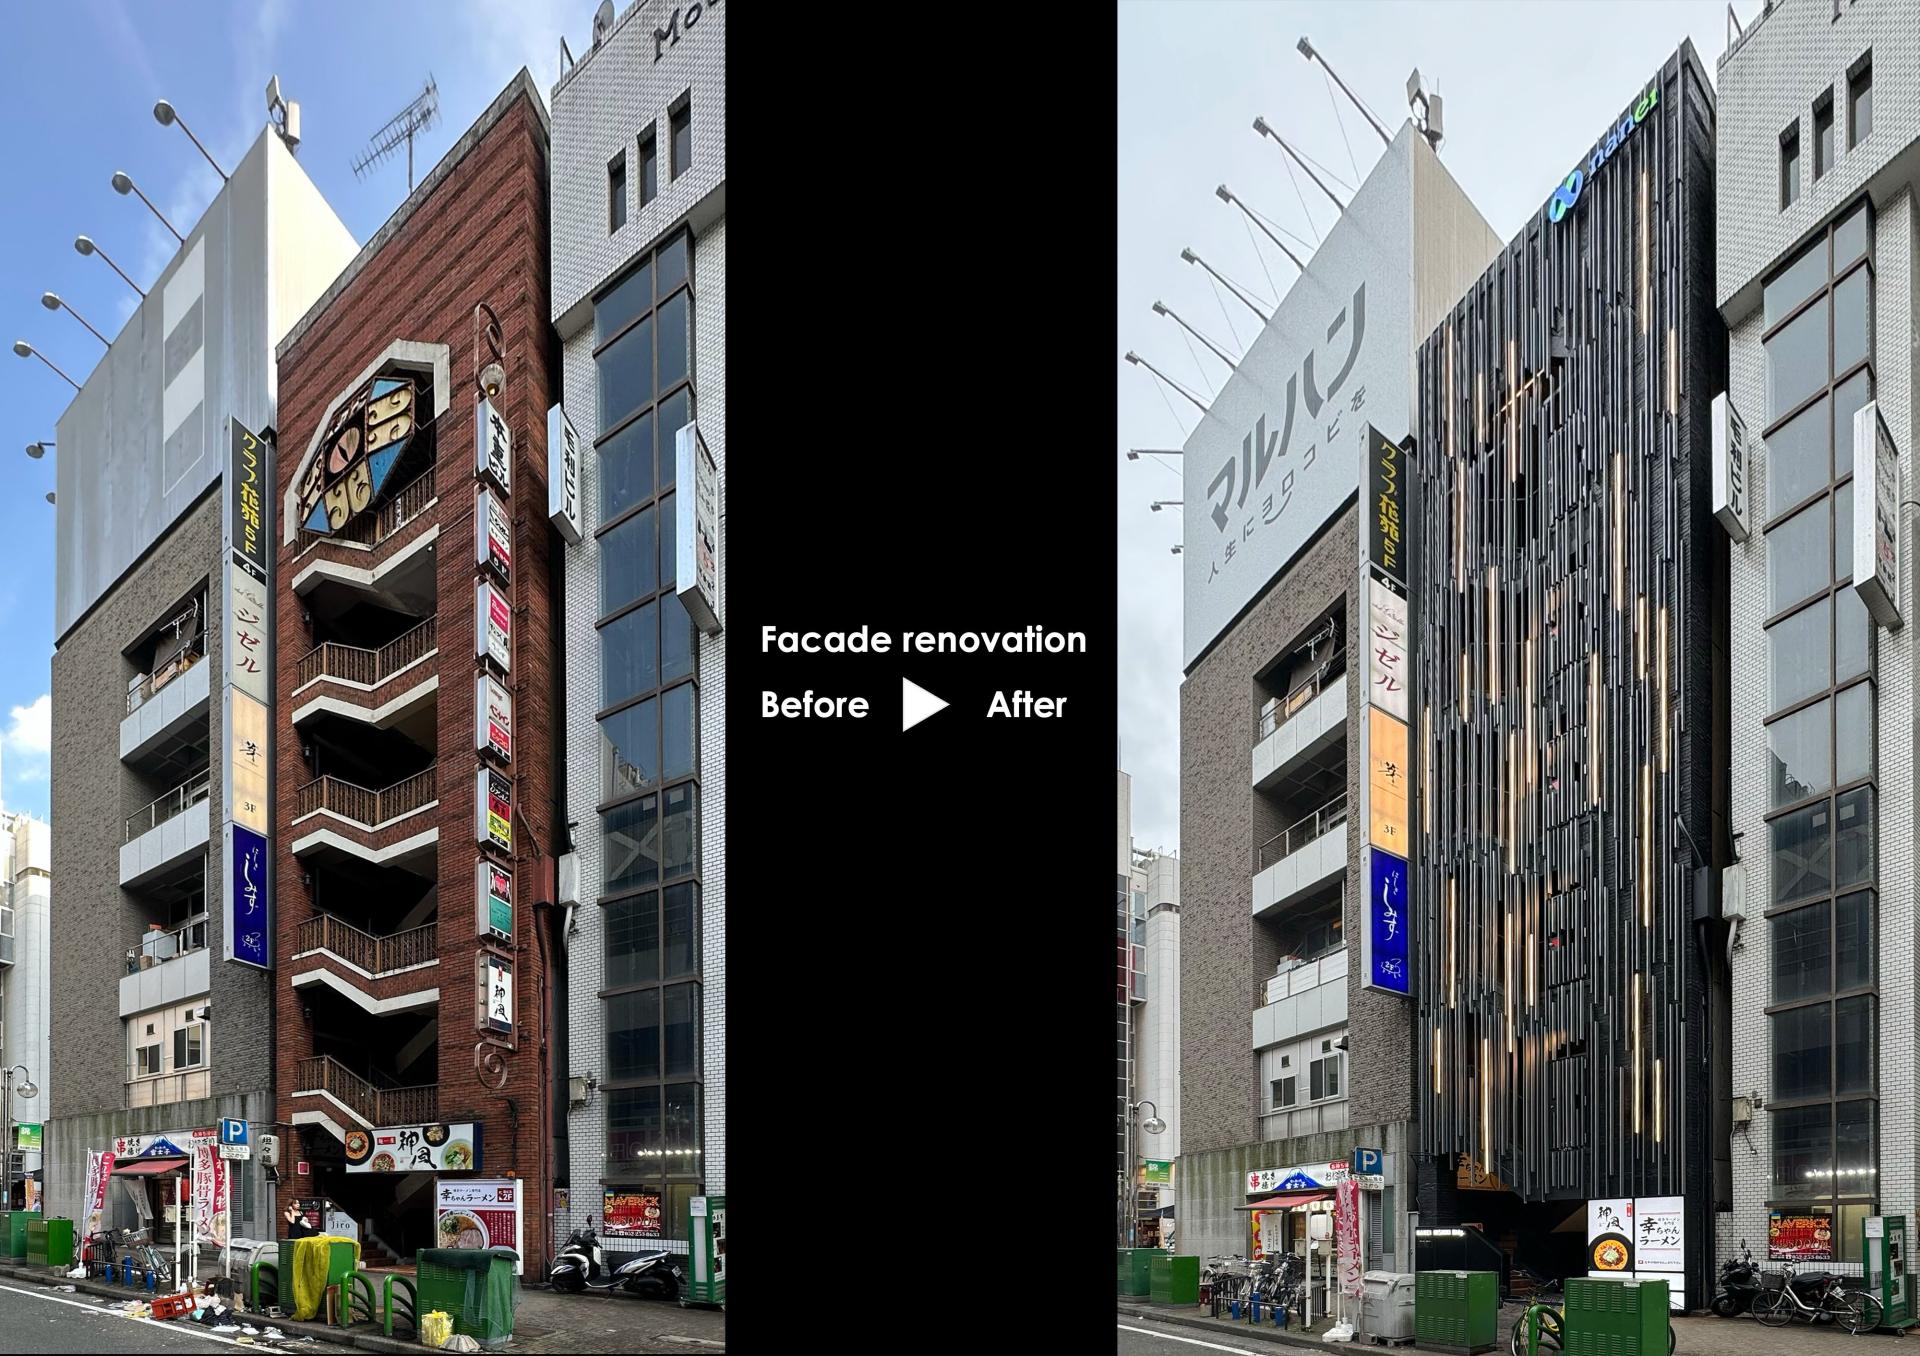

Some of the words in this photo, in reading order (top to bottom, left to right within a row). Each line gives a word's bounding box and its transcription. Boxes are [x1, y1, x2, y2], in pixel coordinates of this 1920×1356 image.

[654, 0, 718, 63] Mo
[1207, 280, 1365, 533] マルハン
[1208, 385, 1366, 584] 人生にヨロコビを
[243, 563, 257, 577] 4F
[1381, 577, 1397, 592] 4F
[236, 607, 262, 673] ジゼル
[1375, 624, 1402, 692] ジゼル
[244, 801, 256, 813] 3F
[1384, 825, 1397, 836] 3F
[230, 1121, 243, 1141] P
[397, 1130, 438, 1169] 神風
[1363, 1151, 1378, 1171] P
[196, 1146, 212, 1236] 博多豚骨ラーメン
[1250, 1172, 1260, 1191] 串
[503, 1193, 512, 1201] 2F
[604, 1196, 660, 1206] MAVERICK
[1771, 1218, 1831, 1229] MAVERICK
[1640, 1236, 1680, 1246] ラーメン
